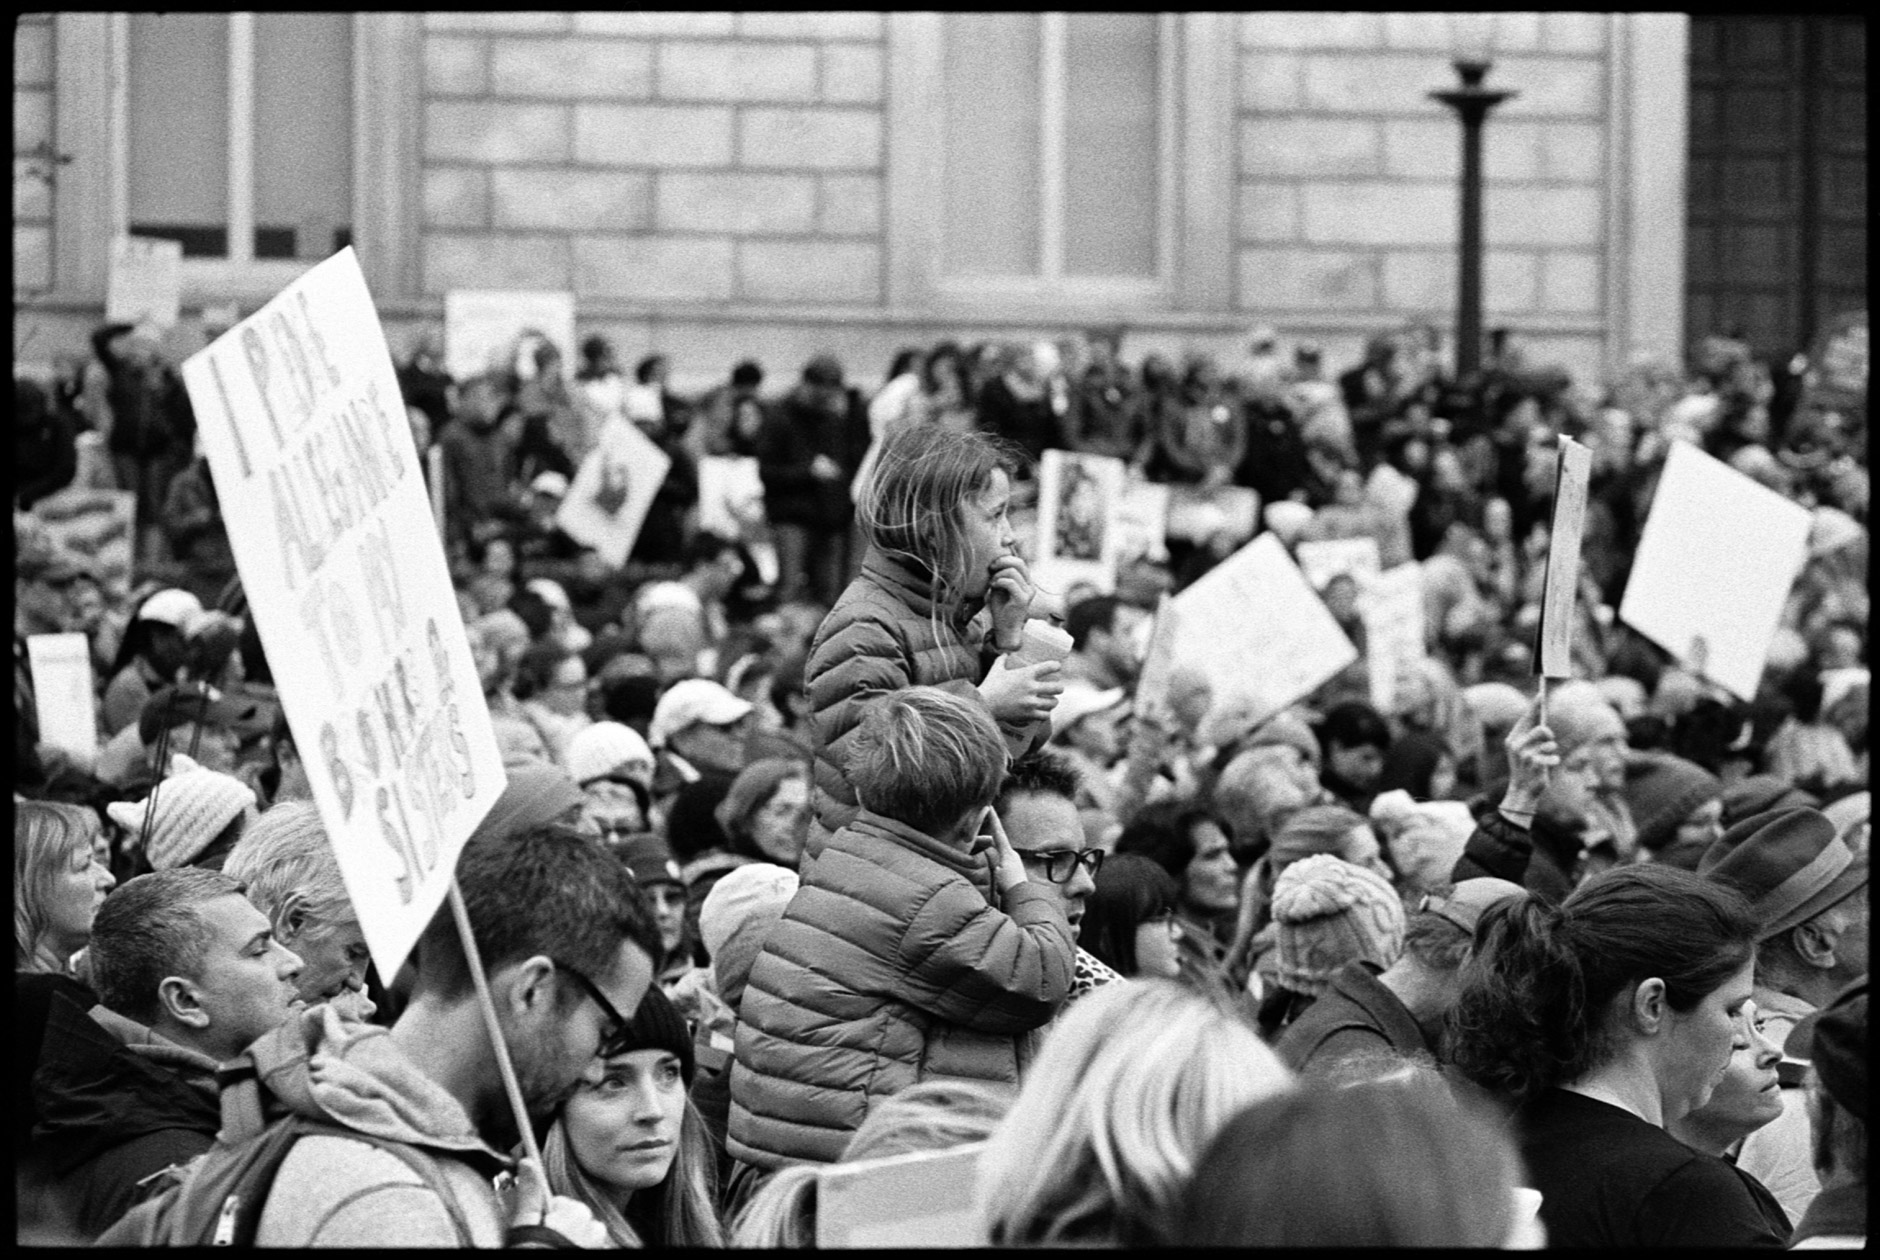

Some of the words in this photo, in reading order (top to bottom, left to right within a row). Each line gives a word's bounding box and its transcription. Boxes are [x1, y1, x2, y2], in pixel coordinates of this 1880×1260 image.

[210, 354, 252, 478] I
[241, 291, 341, 449] PEDE
[298, 576, 361, 701] TO
